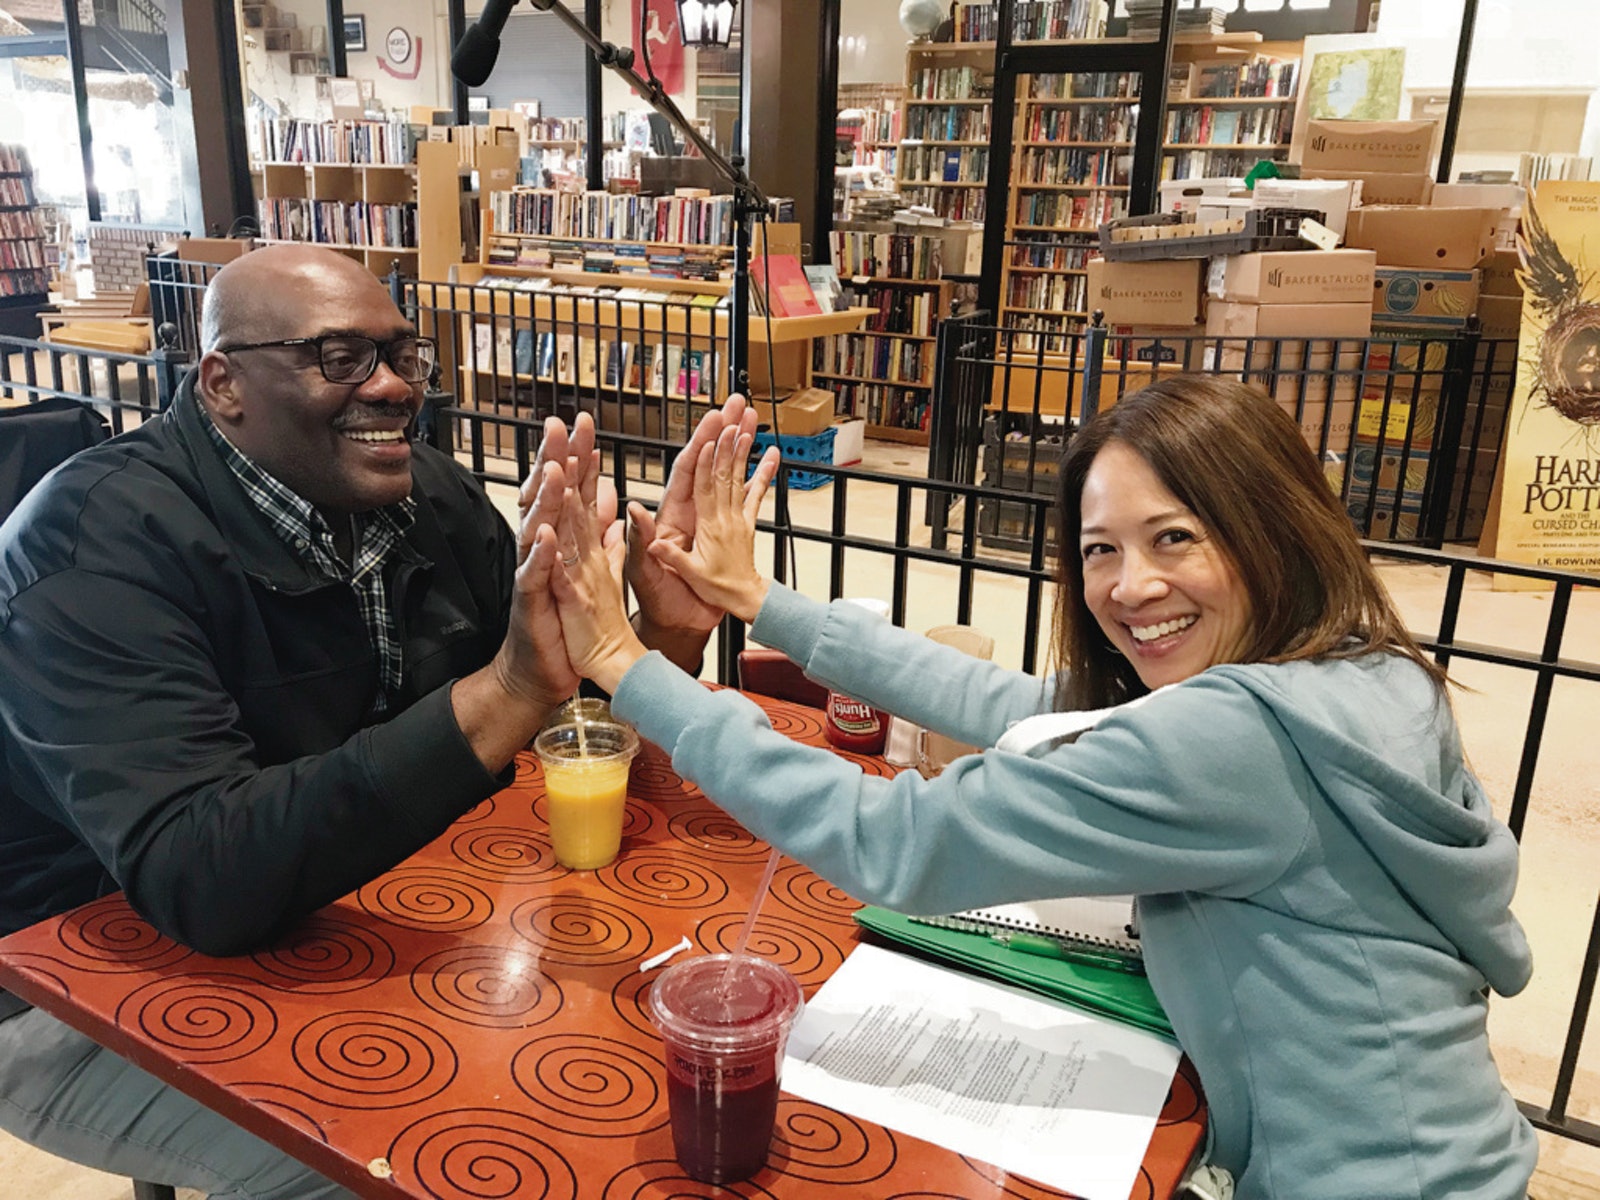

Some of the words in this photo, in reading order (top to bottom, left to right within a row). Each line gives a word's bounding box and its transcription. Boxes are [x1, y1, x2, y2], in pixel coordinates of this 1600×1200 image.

[1523, 483, 1600, 514] POTT
[1533, 519, 1578, 530] CURSED
[1580, 519, 1600, 529] CH
